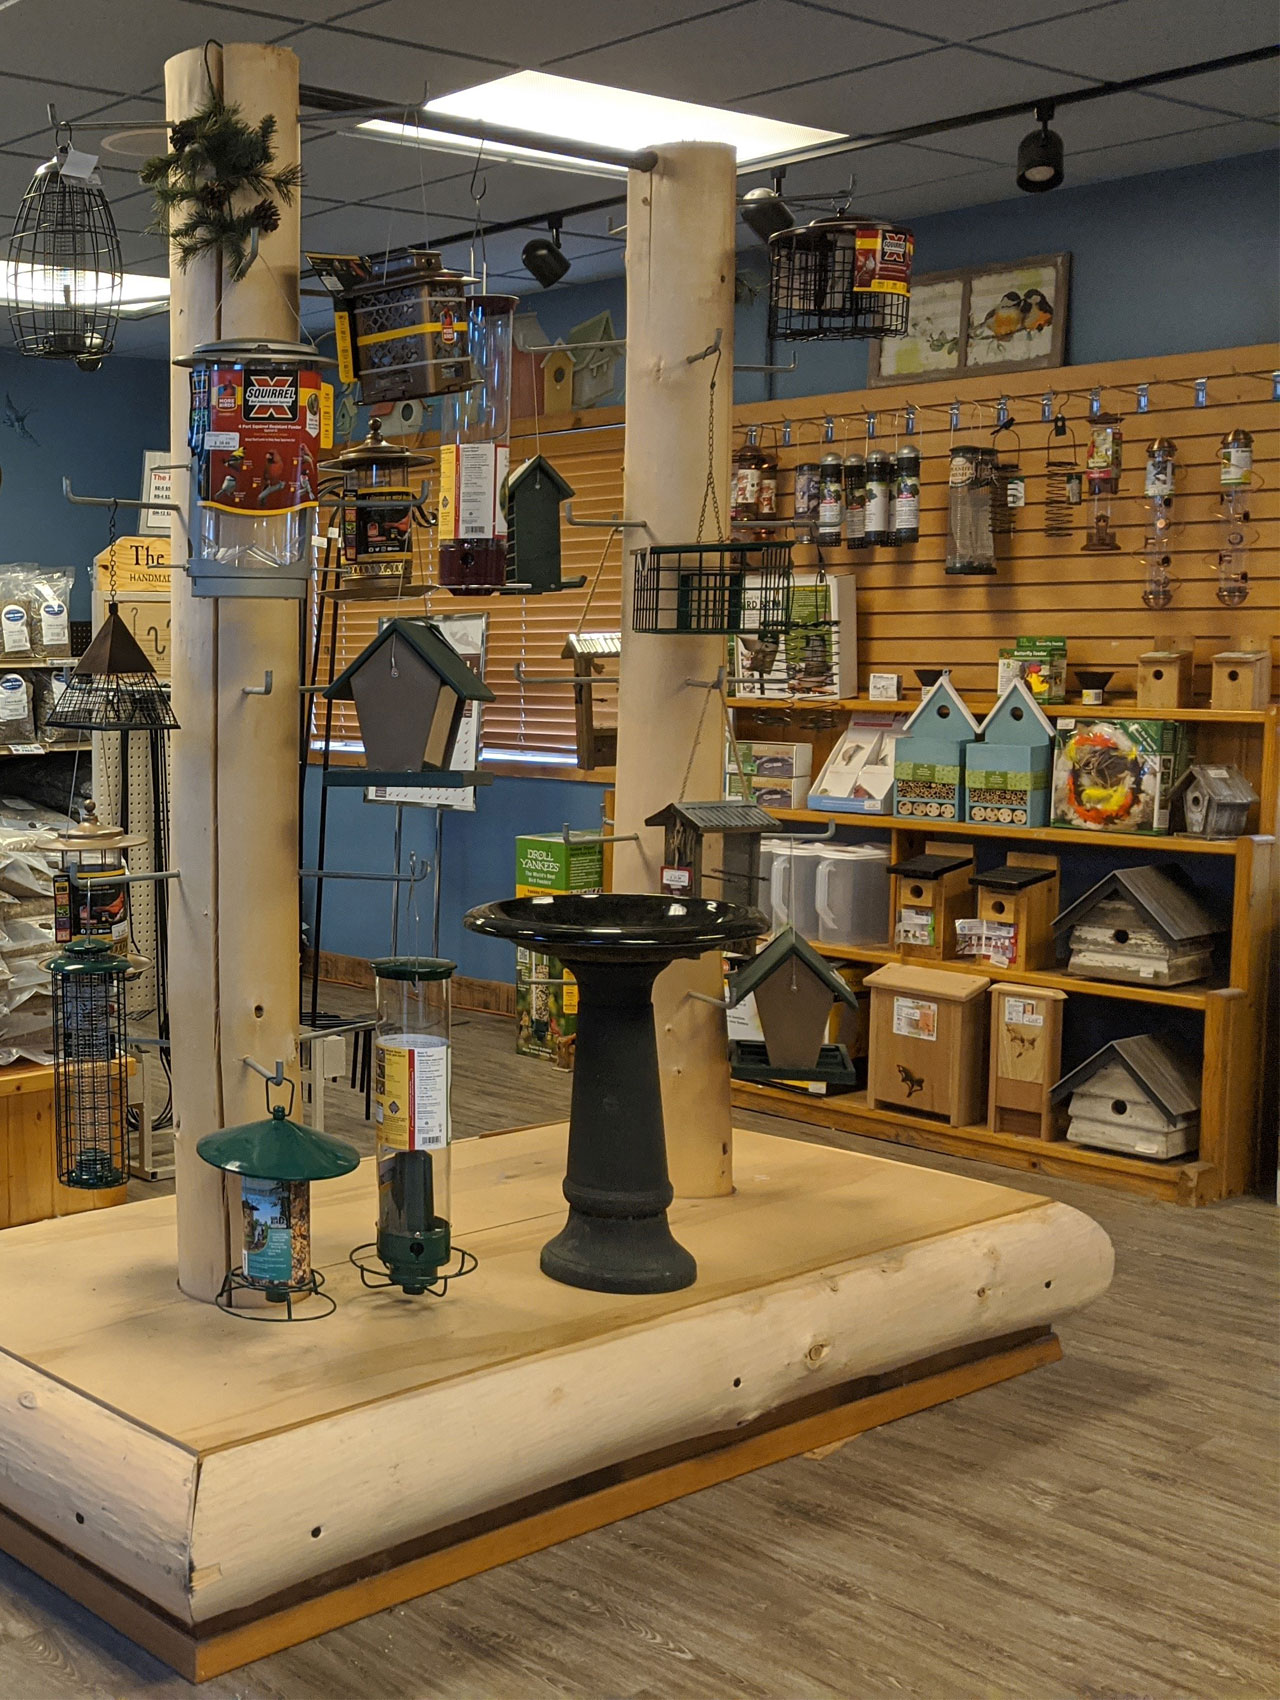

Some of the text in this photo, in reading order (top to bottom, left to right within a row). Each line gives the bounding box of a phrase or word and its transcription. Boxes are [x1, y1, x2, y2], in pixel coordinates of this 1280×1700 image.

[246, 387, 296, 399] SQUIRREL
[130, 545, 165, 566] The
[129, 573, 172, 583] HANDMAD
[527, 849, 554, 861] DROLL
[520, 859, 560, 872] YANKEES
